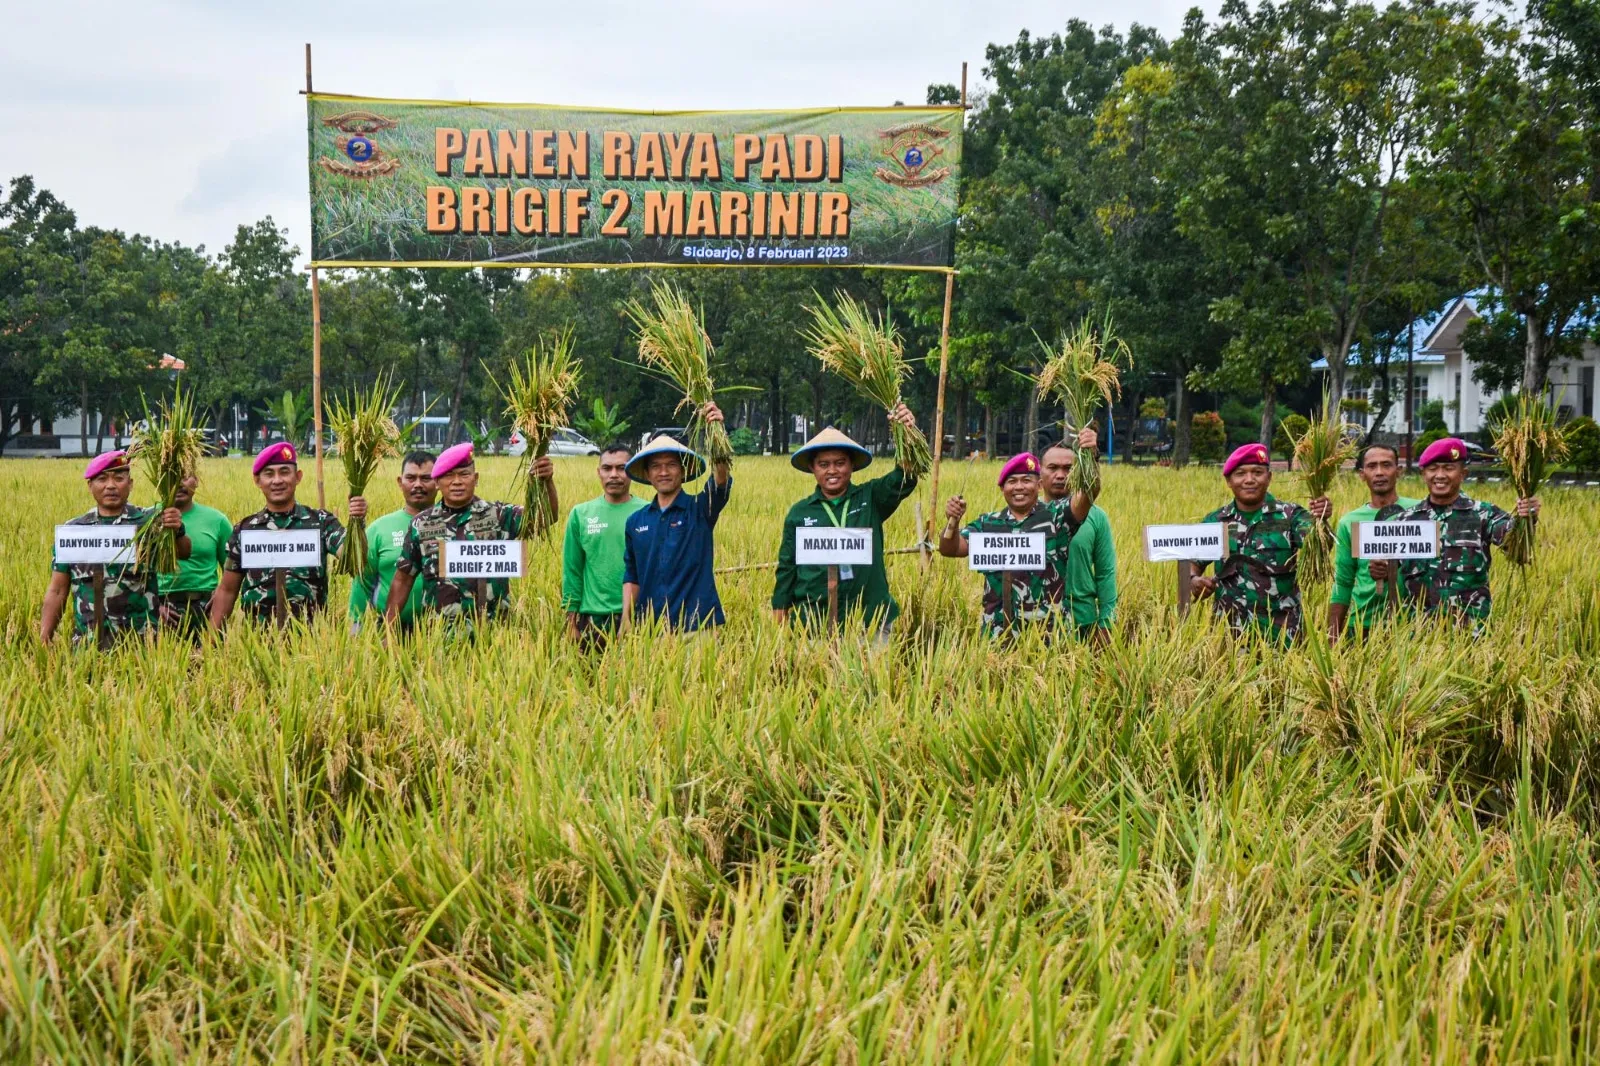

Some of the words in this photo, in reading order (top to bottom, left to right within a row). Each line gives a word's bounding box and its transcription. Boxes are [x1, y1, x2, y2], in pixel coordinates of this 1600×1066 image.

[352, 141, 367, 158] 2
[434, 128, 588, 177] PANEN
[602, 131, 720, 179] RAYA
[732, 134, 841, 180] PADI
[908, 150, 920, 164] 2
[425, 186, 589, 234] BRIGIF
[601, 190, 630, 235] 2
[643, 192, 850, 236] MARINIR
[682, 245, 744, 262] Sidoarjo,
[746, 247, 756, 258] 8
[758, 246, 815, 259] Februari
[817, 246, 849, 258] 2023
[1373, 524, 1422, 537] DANKIMA
[59, 538, 103, 548] DANYONIF
[104, 538, 111, 548] 5
[113, 538, 132, 548] MAR
[244, 543, 288, 554] DANYONIF
[289, 543, 295, 553] 3
[296, 543, 316, 553] MAR
[803, 538, 838, 551] MAXXI
[839, 538, 865, 550] TANI
[983, 536, 1031, 549] PASINTEL
[1152, 537, 1194, 548] DANYONIF
[1194, 537, 1199, 546] 1
[1200, 536, 1219, 546] MAR
[1363, 542, 1398, 554] BRIGIF
[1399, 542, 1407, 554] 2
[1408, 542, 1432, 554] MAR
[459, 544, 506, 556] PASPERS
[973, 553, 1008, 565] BRIGIF
[1009, 553, 1016, 565] 2
[1018, 553, 1042, 565] MAR
[448, 561, 483, 573] BRIGIF
[486, 561, 493, 572] 2
[495, 561, 518, 573] MAR
